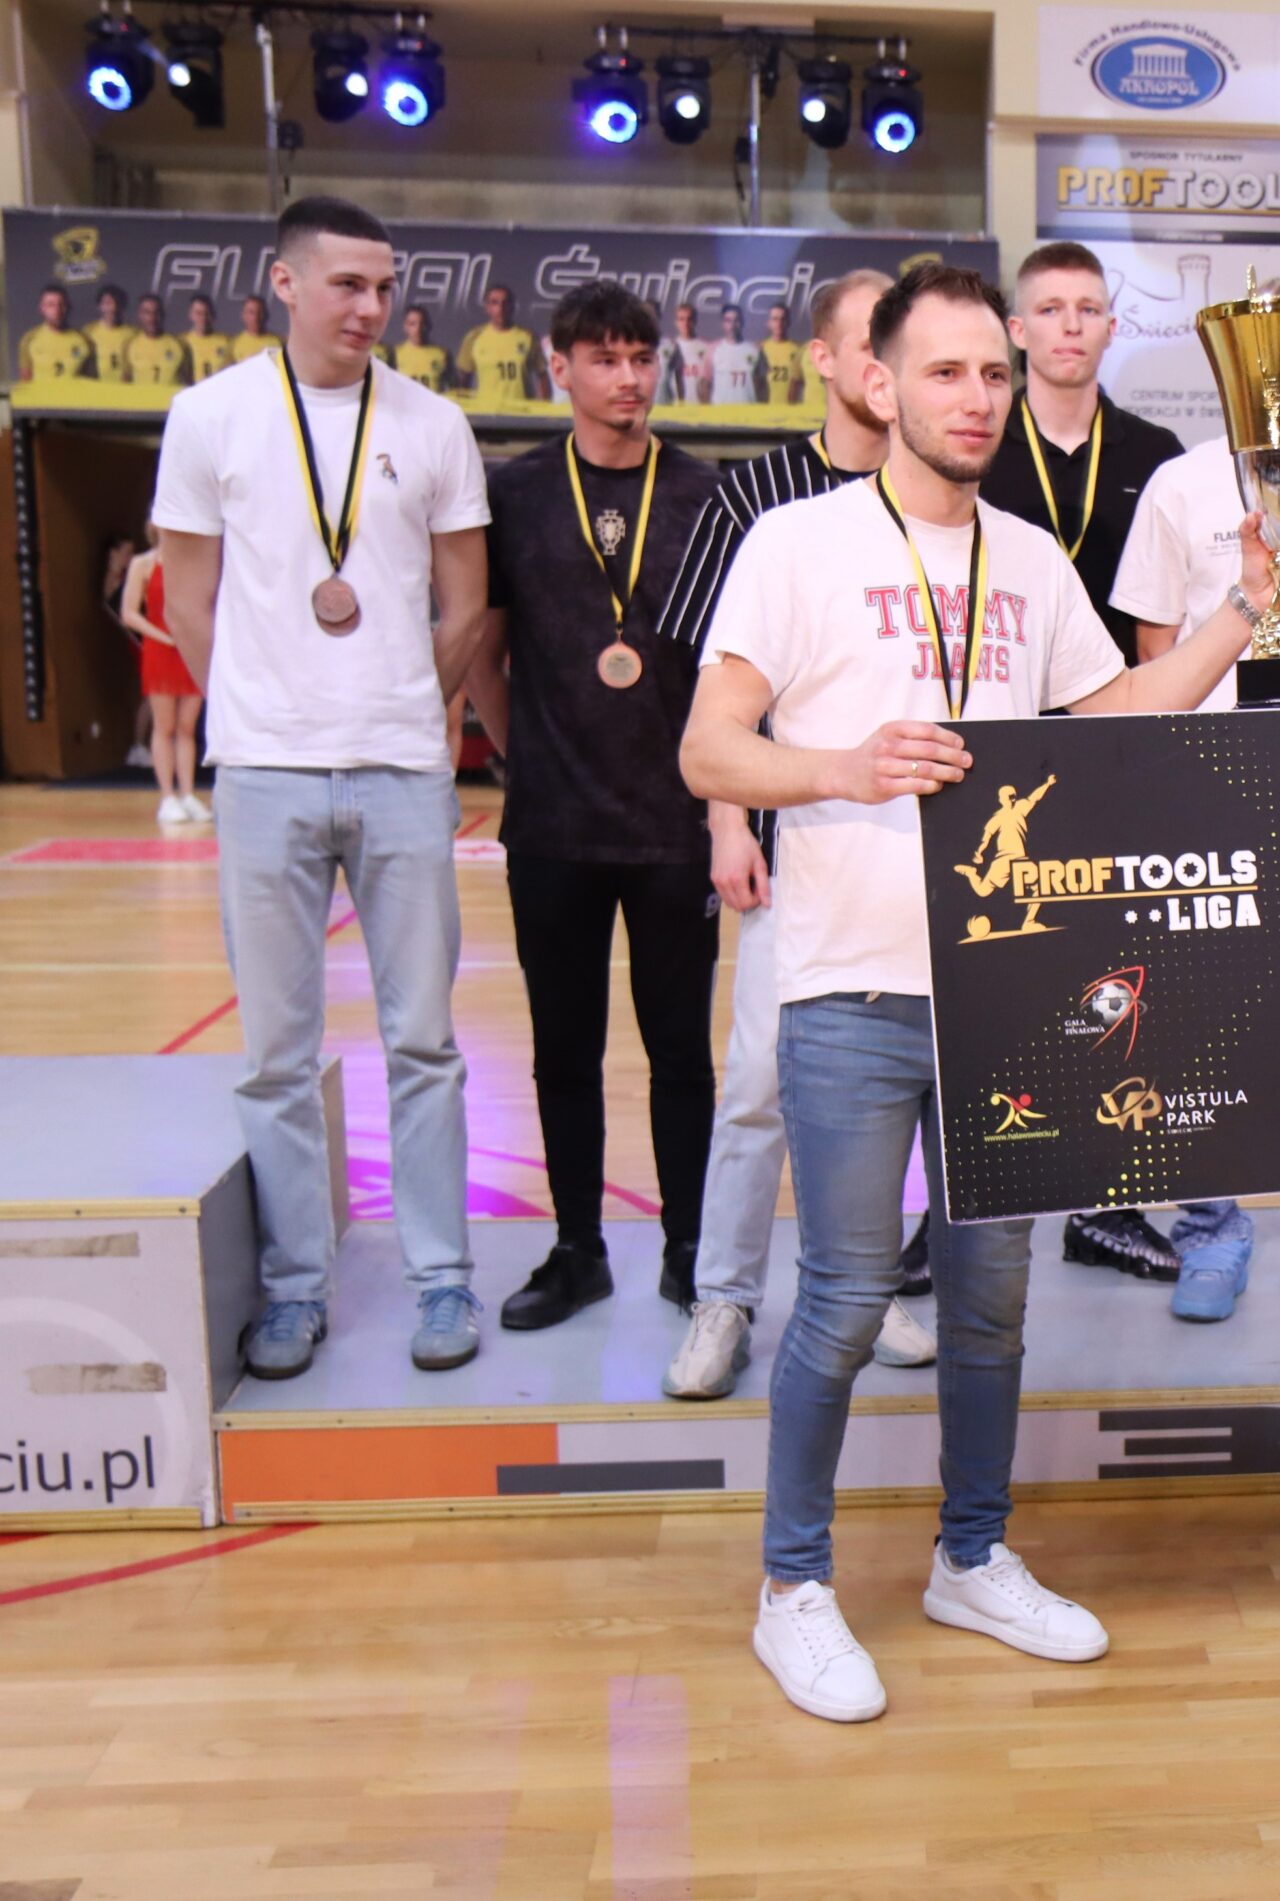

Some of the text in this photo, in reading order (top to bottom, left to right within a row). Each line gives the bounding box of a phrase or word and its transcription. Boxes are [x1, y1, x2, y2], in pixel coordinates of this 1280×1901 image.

[1119, 78, 1199, 96] AKROPOL
[1012, 850, 1258, 897] PROFTOOLS
[1167, 894, 1261, 932] LIGA
[1064, 1019, 1086, 1027] GALA
[1165, 1089, 1248, 1110] VISTULA
[1167, 1109, 1216, 1127] PARK
